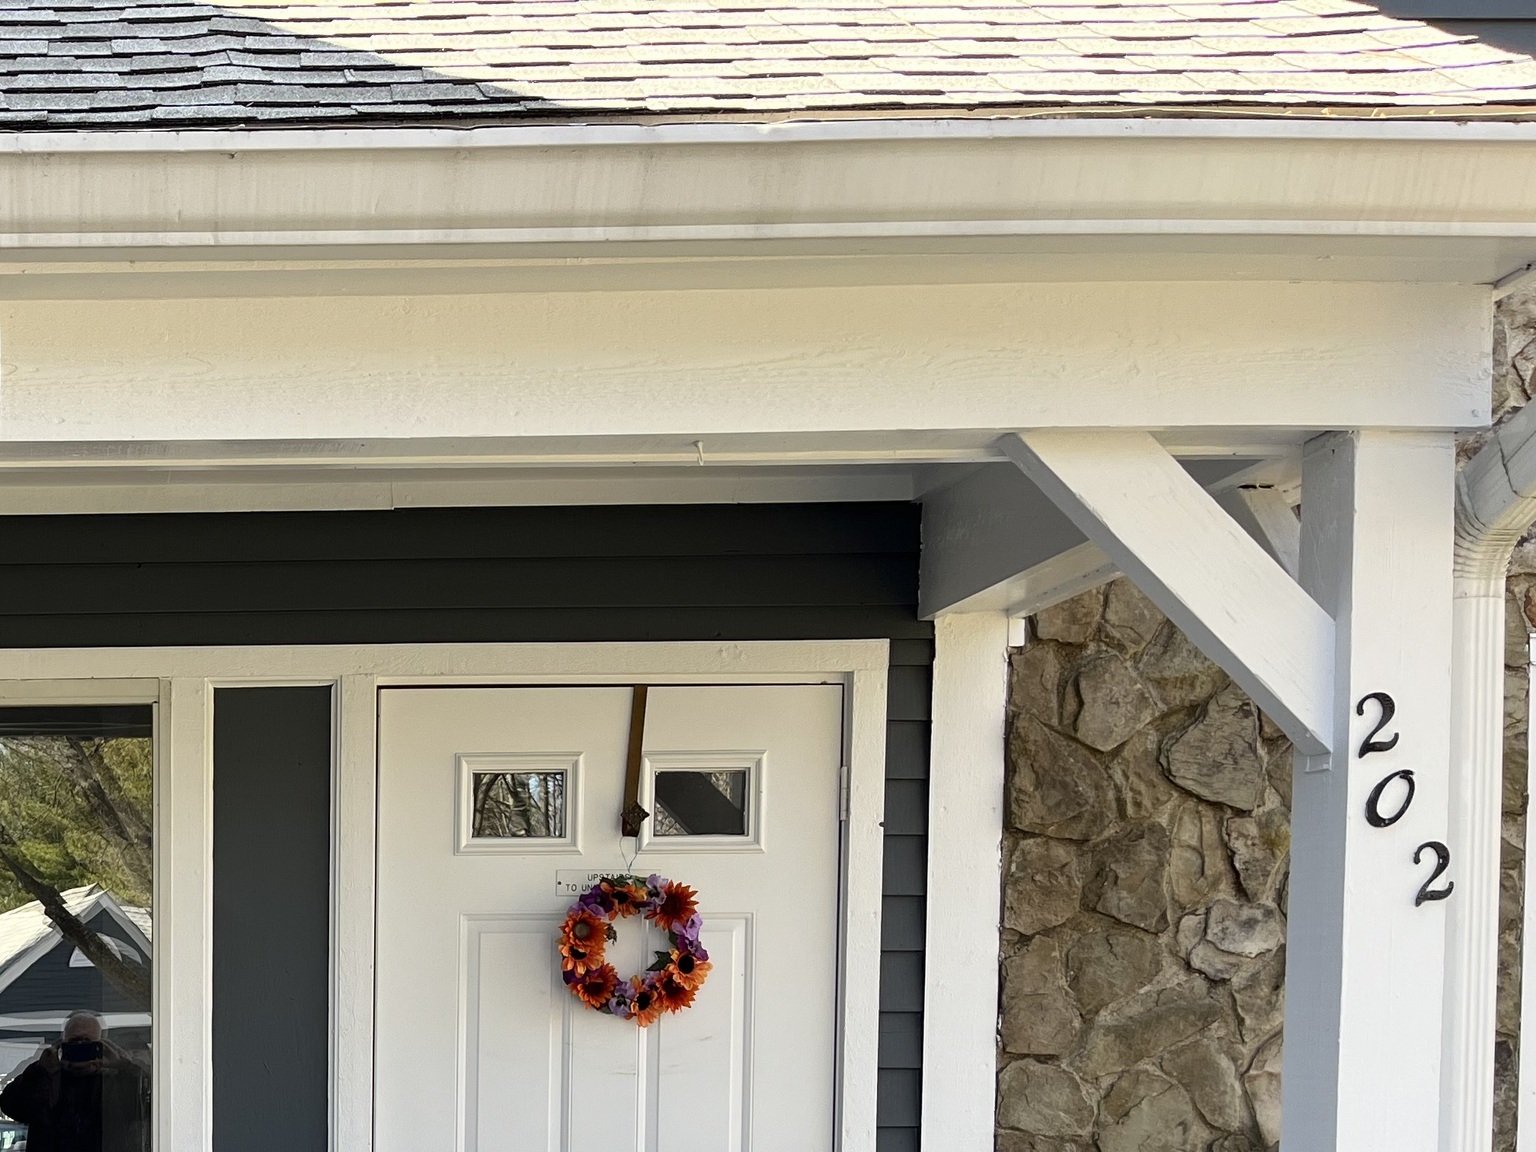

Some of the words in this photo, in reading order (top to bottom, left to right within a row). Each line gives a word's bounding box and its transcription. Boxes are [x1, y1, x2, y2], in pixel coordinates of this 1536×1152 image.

[1356, 691, 1455, 908] 202
[566, 884, 578, 892] TO
[581, 884, 593, 892] UN
